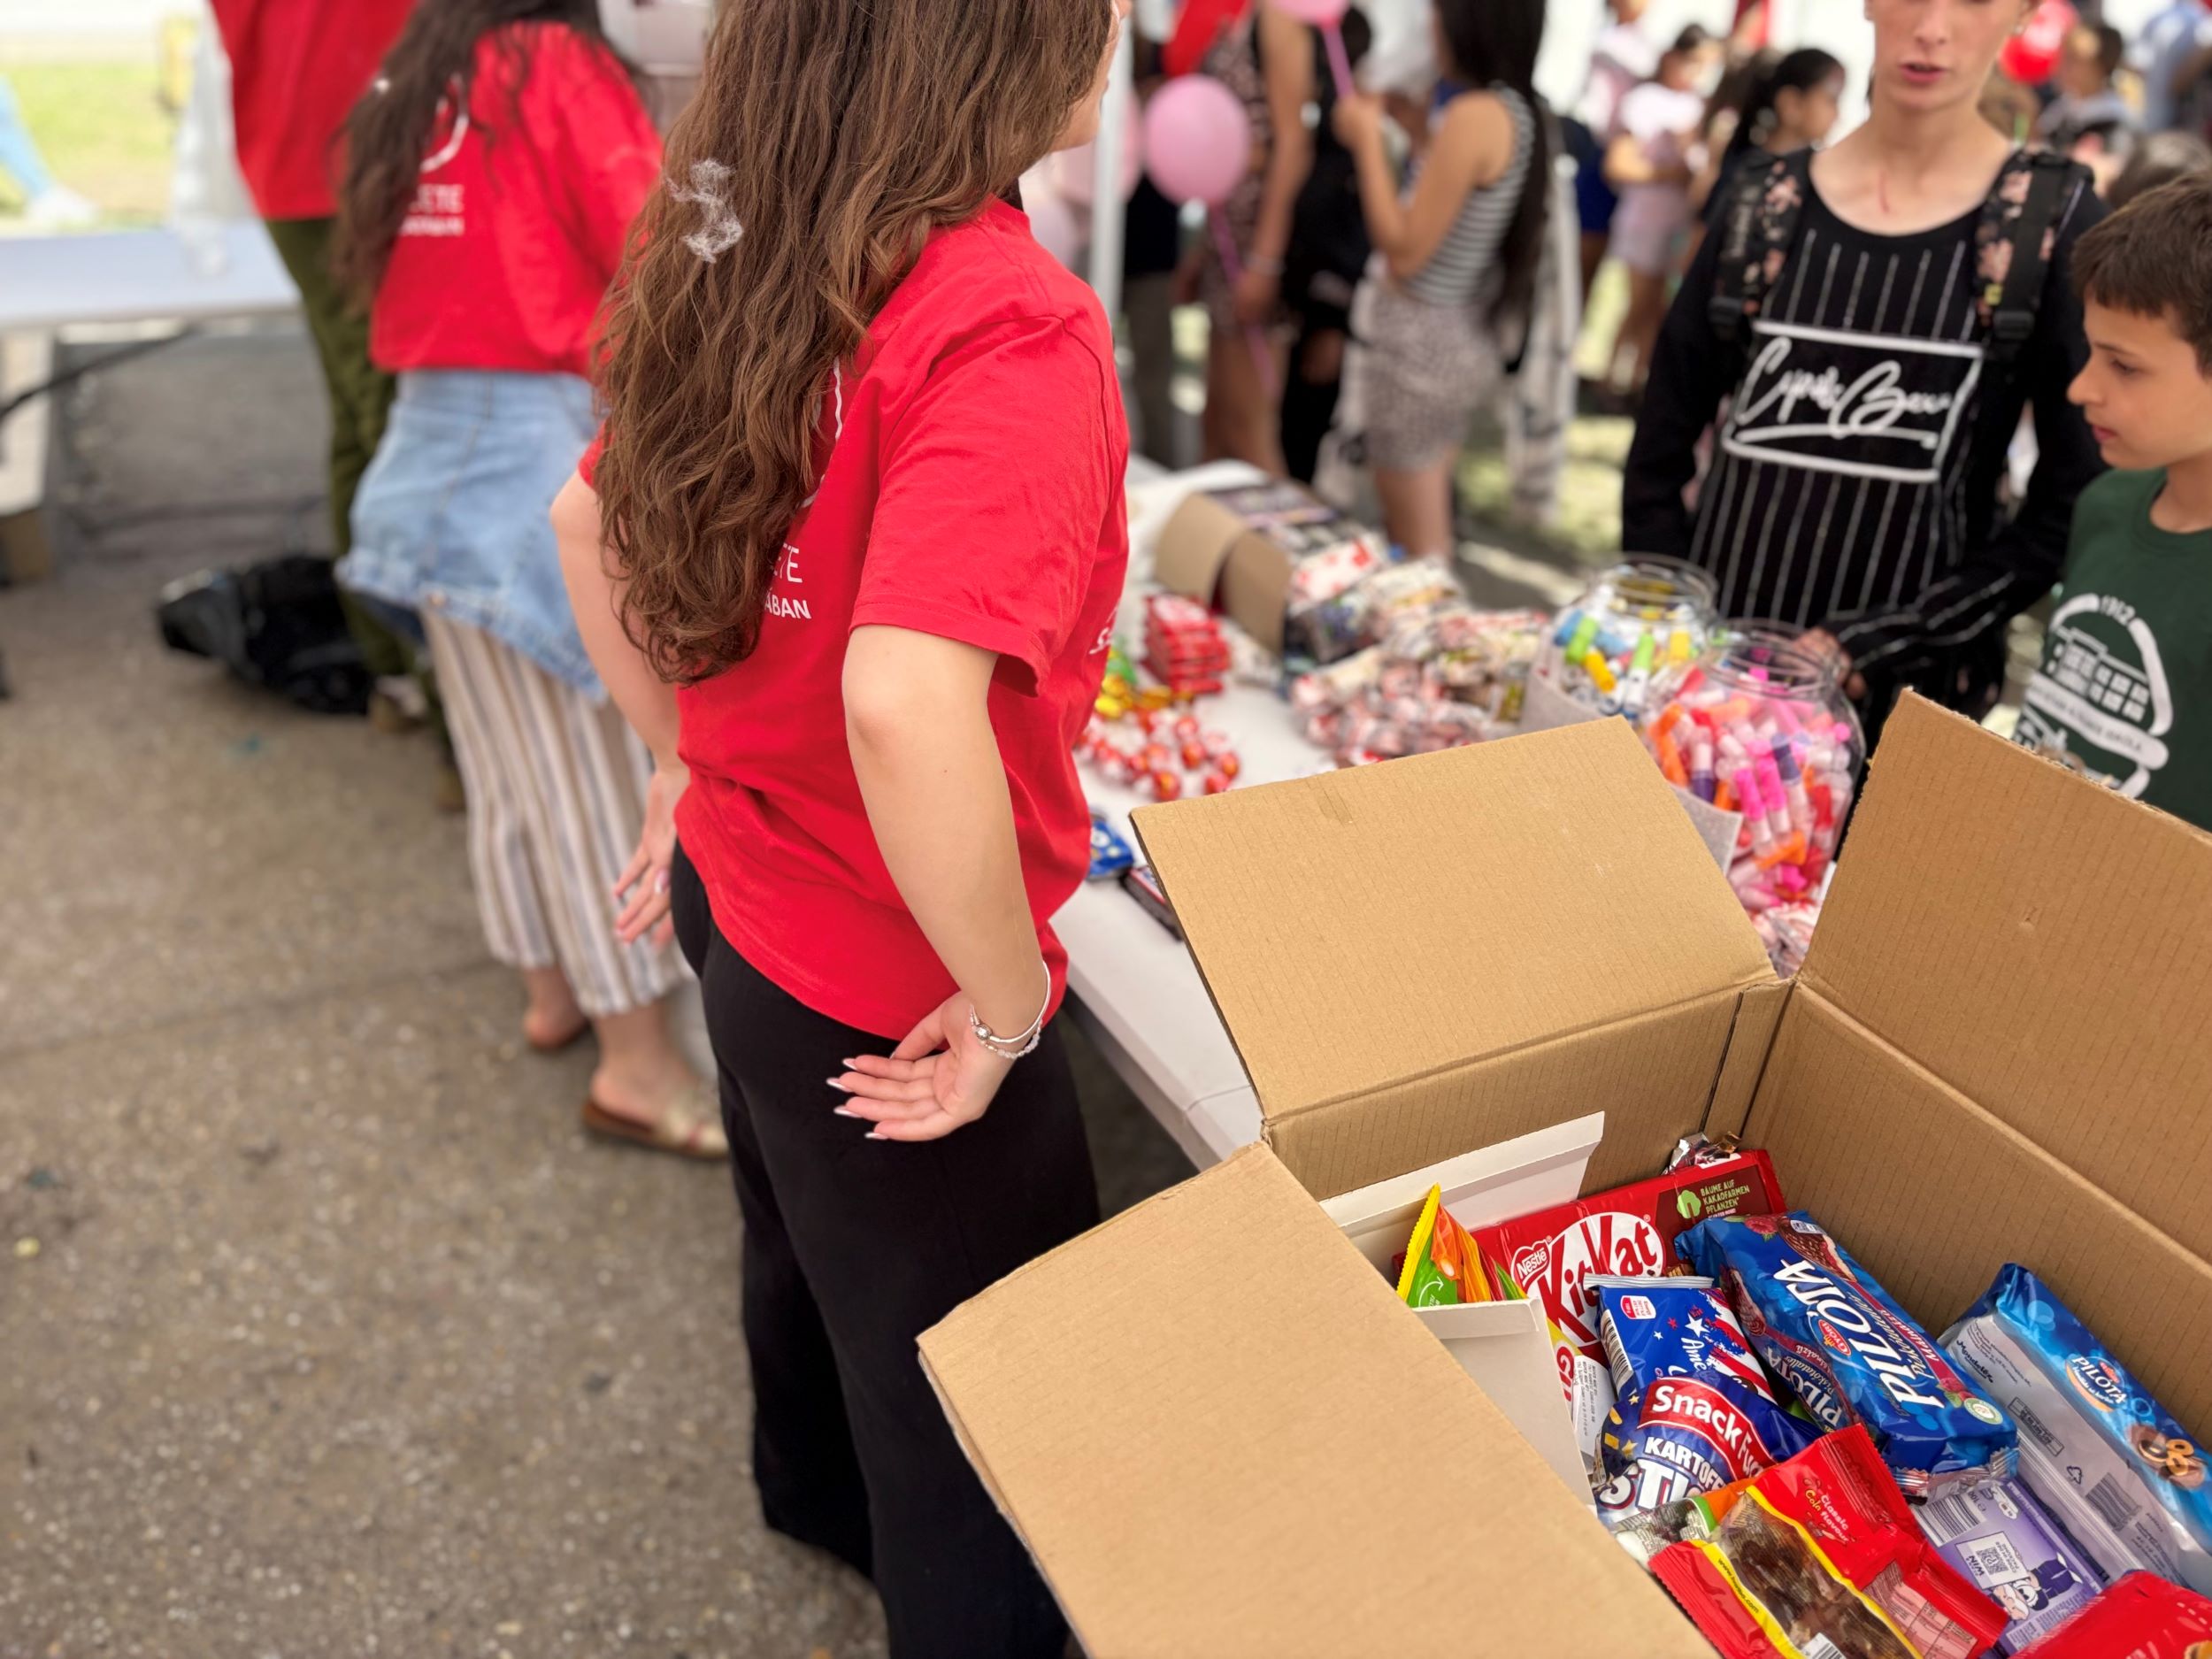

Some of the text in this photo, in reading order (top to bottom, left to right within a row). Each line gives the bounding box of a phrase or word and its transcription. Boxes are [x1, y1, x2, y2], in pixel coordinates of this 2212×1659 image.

[1537, 1214, 1658, 1343] KitKat
[1772, 1258, 1945, 1409] PILÓTA
[2071, 1356, 2127, 1404] PILÓTA
[1652, 1385, 1743, 1451] Snack
[1805, 1489, 1849, 1543] Cola flavour
[1820, 1494, 1848, 1531] Classic
[1970, 1555, 1985, 1577] WIN
